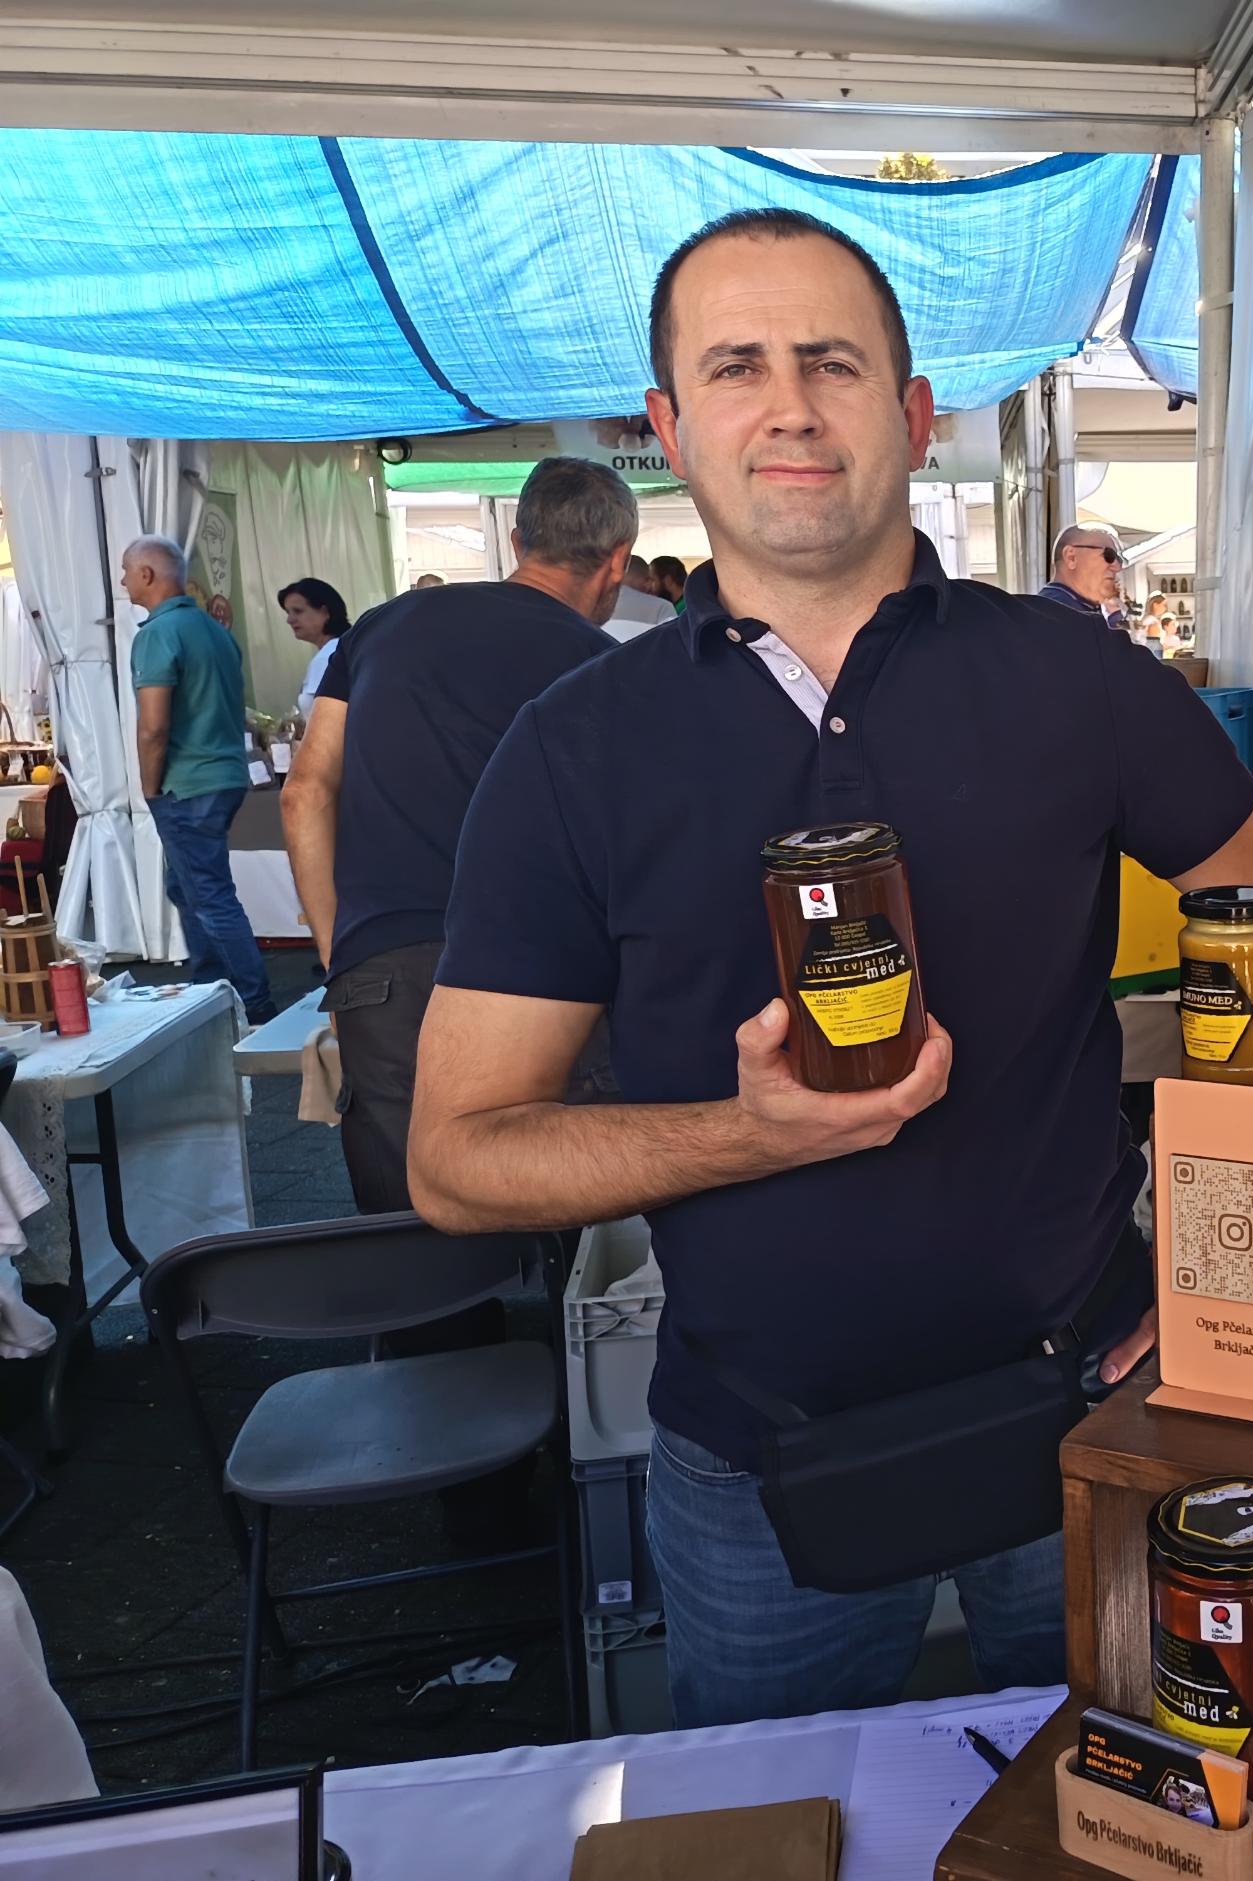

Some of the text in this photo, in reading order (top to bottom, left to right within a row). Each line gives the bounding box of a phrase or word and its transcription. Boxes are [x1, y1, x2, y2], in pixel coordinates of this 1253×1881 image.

[612, 456, 671, 470] OTKU
[805, 954, 889, 975] Lički cvjetni
[866, 961, 896, 980] med
[1208, 996, 1233, 1005] MED
[1196, 1317, 1220, 1333] Opg
[1165, 1680, 1212, 1706] cvjetni
[1184, 1700, 1219, 1723] med
[1088, 1733, 1106, 1746] OPG
[1087, 1745, 1143, 1771] PČELARSTVO
[1086, 1757, 1134, 1781] BRKLJAČIĆ
[1077, 1810, 1204, 1877] Opg Pčelarstvo Brkljačić
